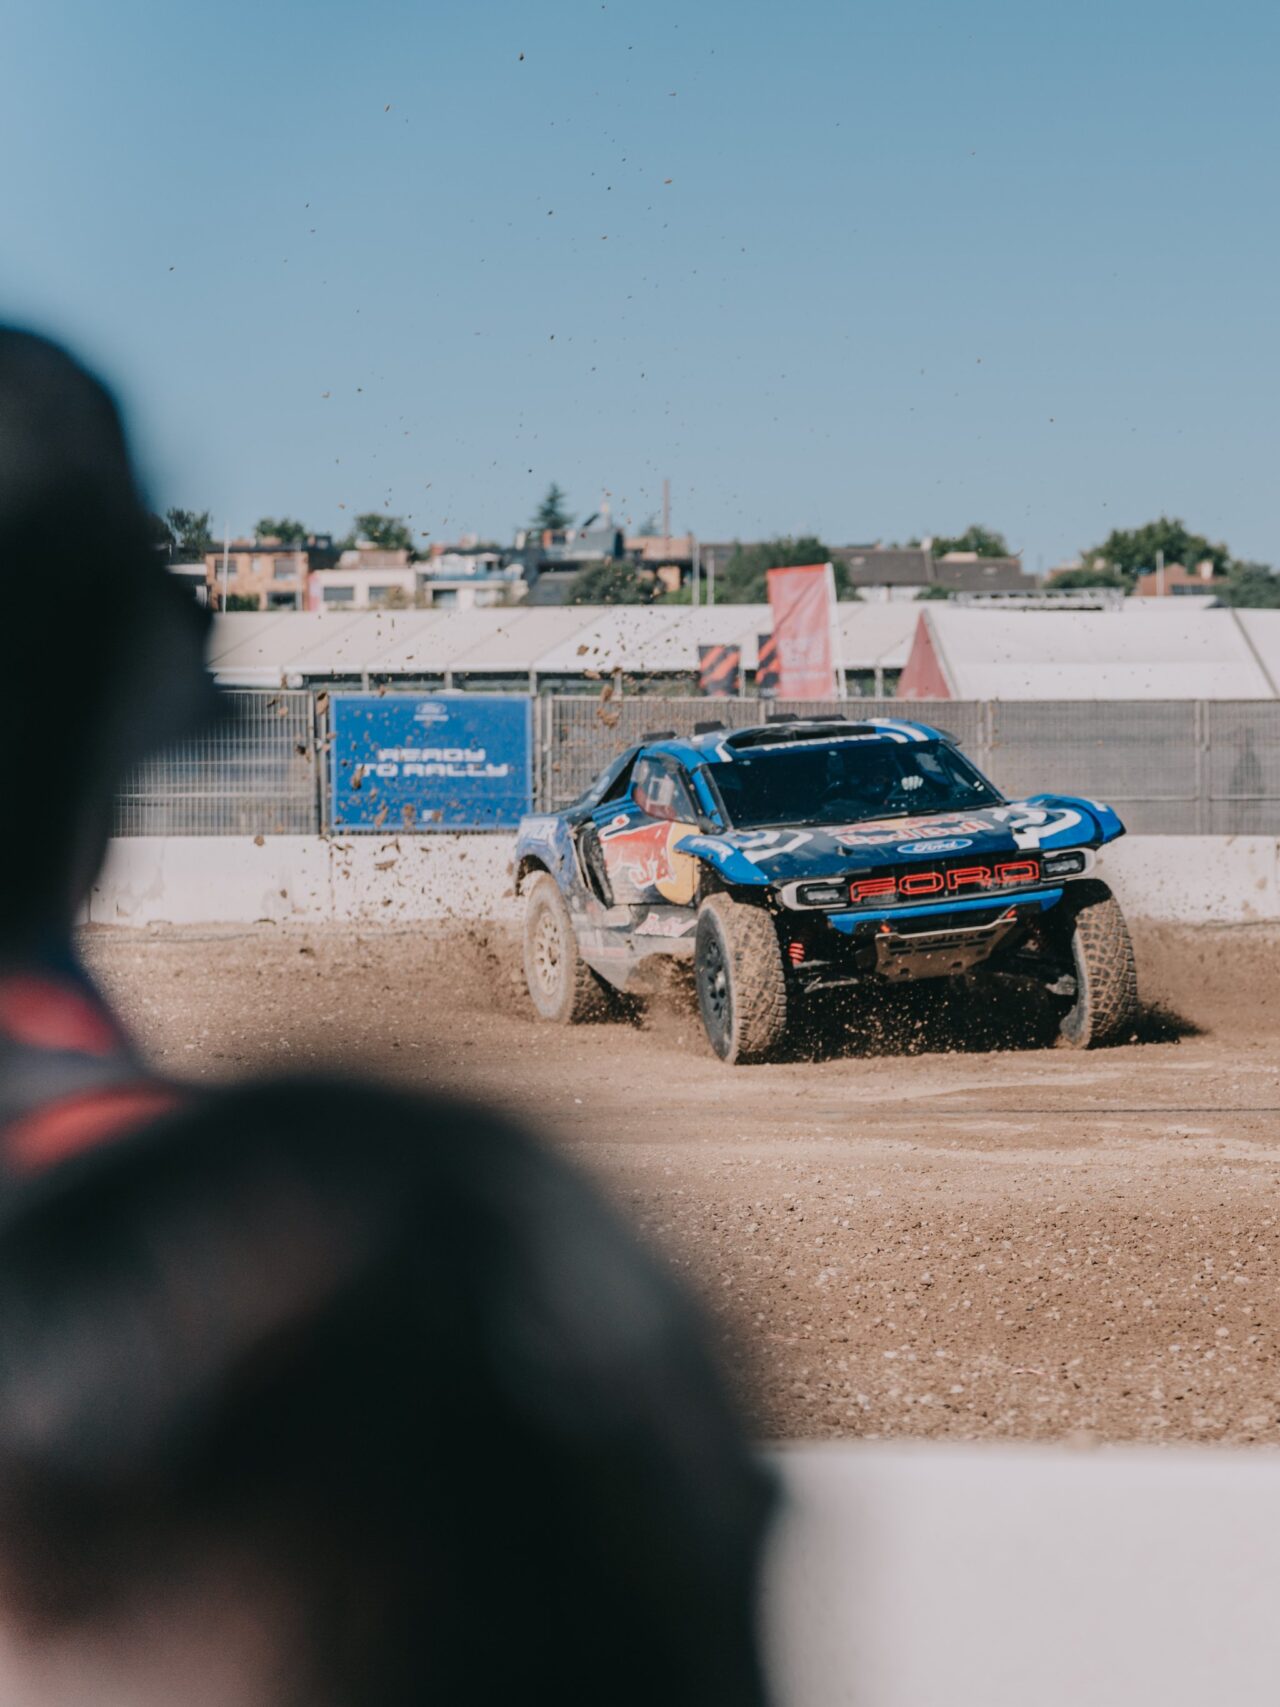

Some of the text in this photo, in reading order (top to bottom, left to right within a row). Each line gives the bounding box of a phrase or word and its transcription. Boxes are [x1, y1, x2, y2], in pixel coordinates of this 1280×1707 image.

[377, 748, 486, 762] READY
[356, 763, 509, 778] TO RALLY
[850, 860, 1040, 903] FORD
